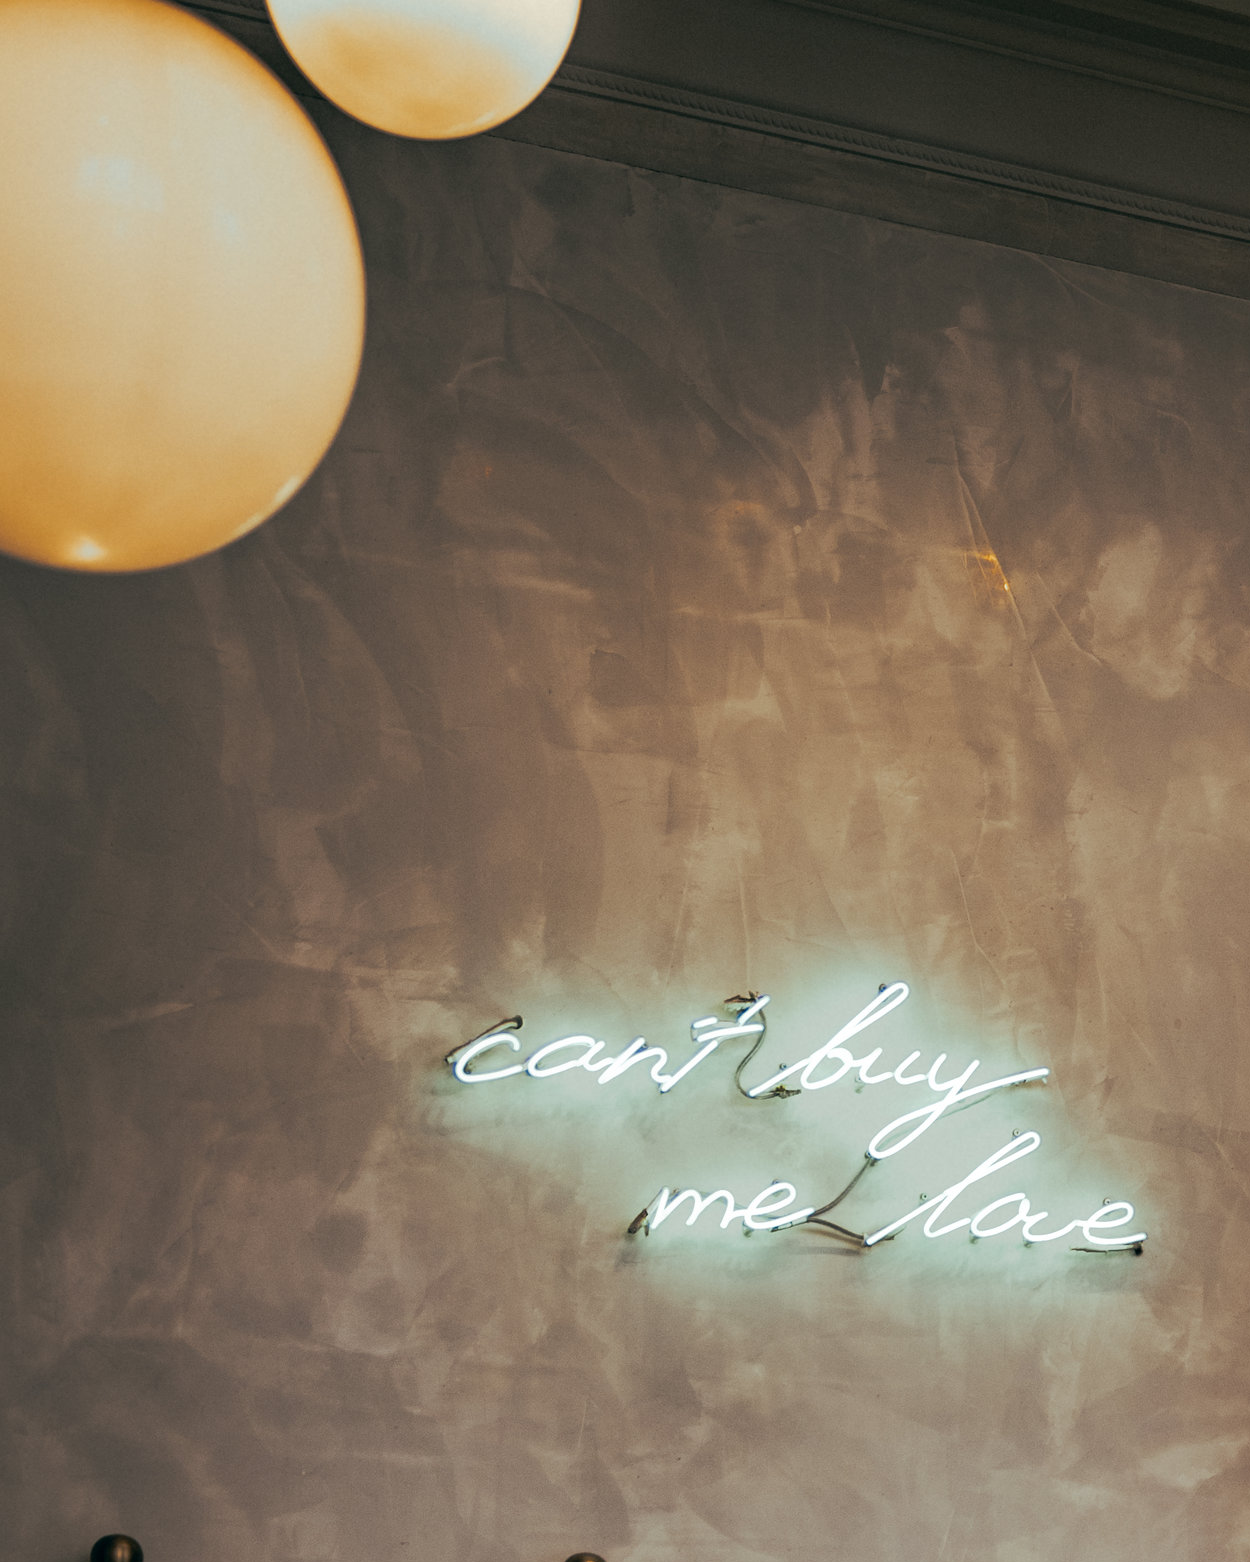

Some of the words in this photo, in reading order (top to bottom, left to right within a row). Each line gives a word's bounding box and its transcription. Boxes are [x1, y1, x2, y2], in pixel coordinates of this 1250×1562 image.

[454, 994, 771, 1094] can't
[748, 981, 1050, 1160] buy
[649, 1181, 814, 1233] me
[866, 1131, 1148, 1247] love
